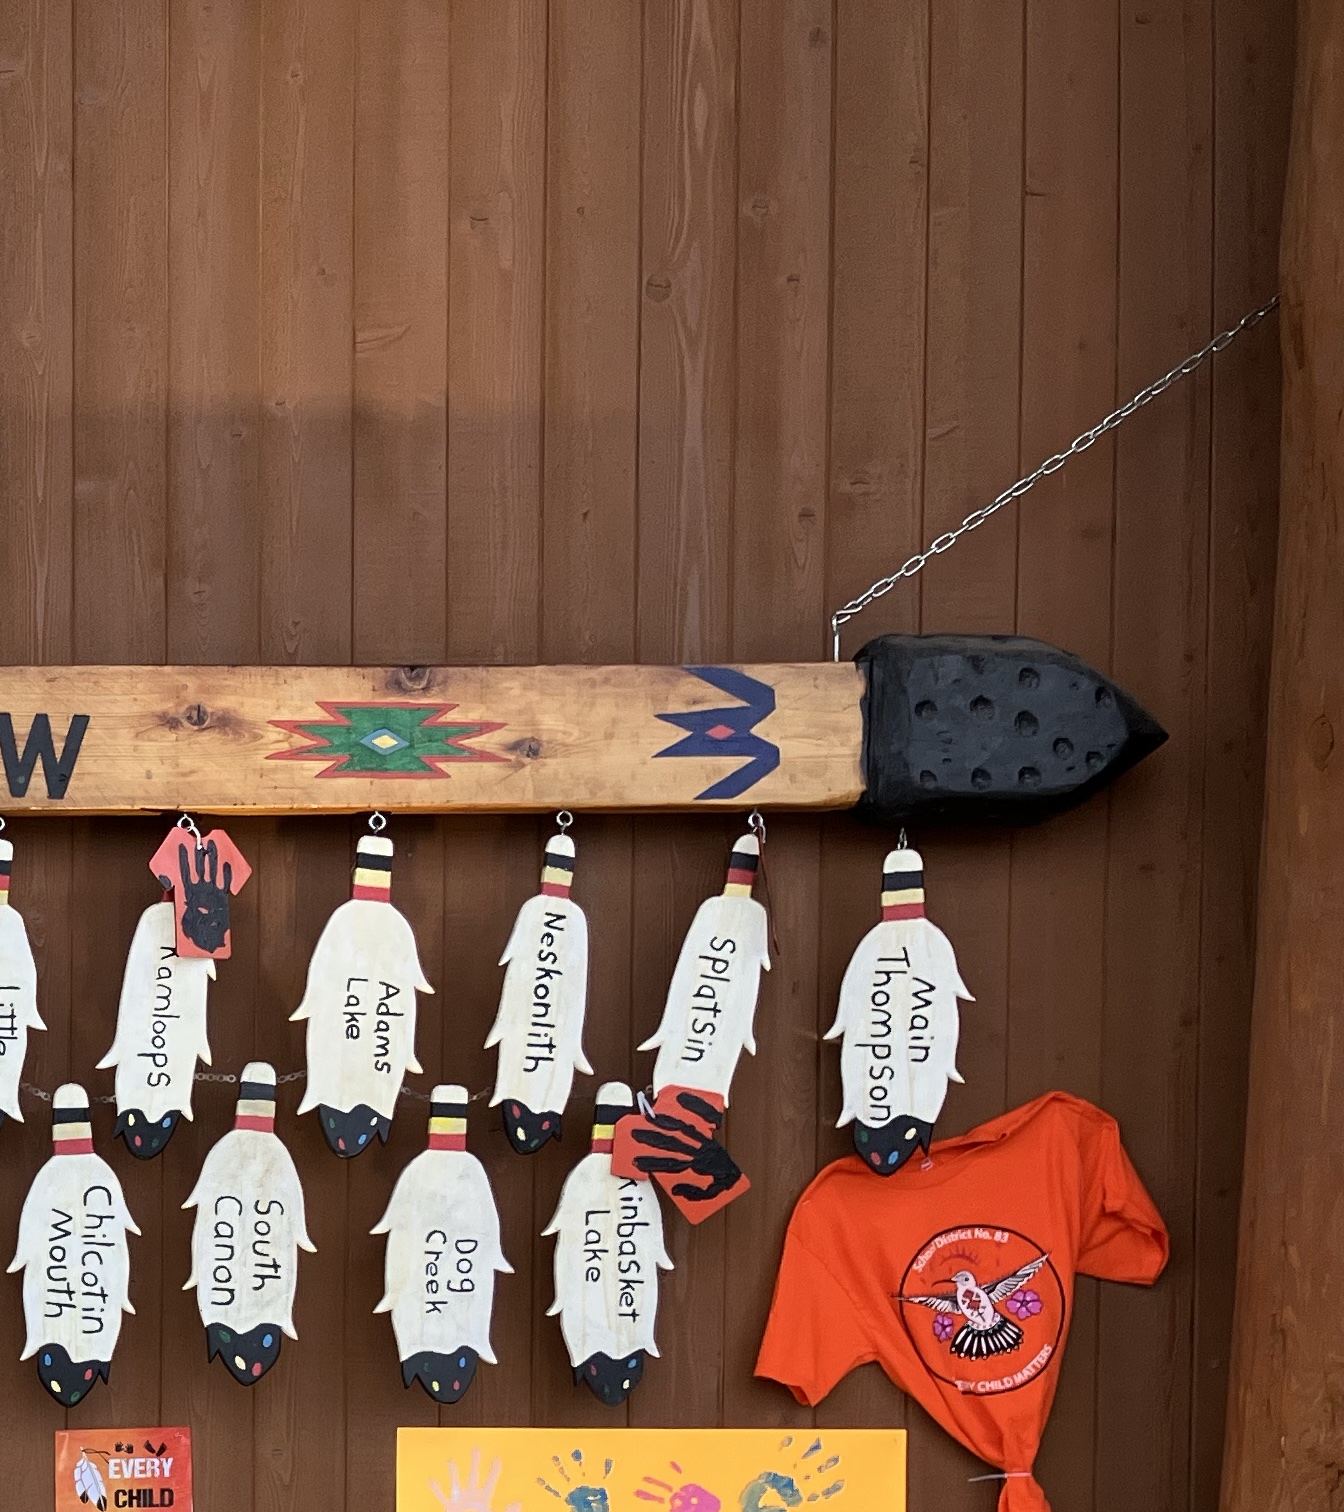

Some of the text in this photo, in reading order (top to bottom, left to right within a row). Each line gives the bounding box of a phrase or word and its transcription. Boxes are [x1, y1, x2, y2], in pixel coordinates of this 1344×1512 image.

[343, 977, 369, 1040] Lake
[373, 981, 405, 1074] Adams
[523, 911, 567, 1073] Neskonlith
[908, 976, 936, 1063] Main
[849, 946, 916, 1128] Thompson
[44, 1208, 77, 1318] Mouth
[81, 1185, 116, 1334] Chilcotin
[210, 1195, 243, 1306] Canon
[252, 1199, 285, 1291] South
[424, 1229, 455, 1314] Creek
[446, 1239, 478, 1293] Dog
[583, 1210, 611, 1283] Lake
[934, 1229, 973, 1249] District
[993, 1230, 1010, 1244] 83
[977, 1343, 1054, 1392] CHILD MATTERS
[108, 1457, 173, 1480] EVERY
[114, 1487, 175, 1509] CHILD
